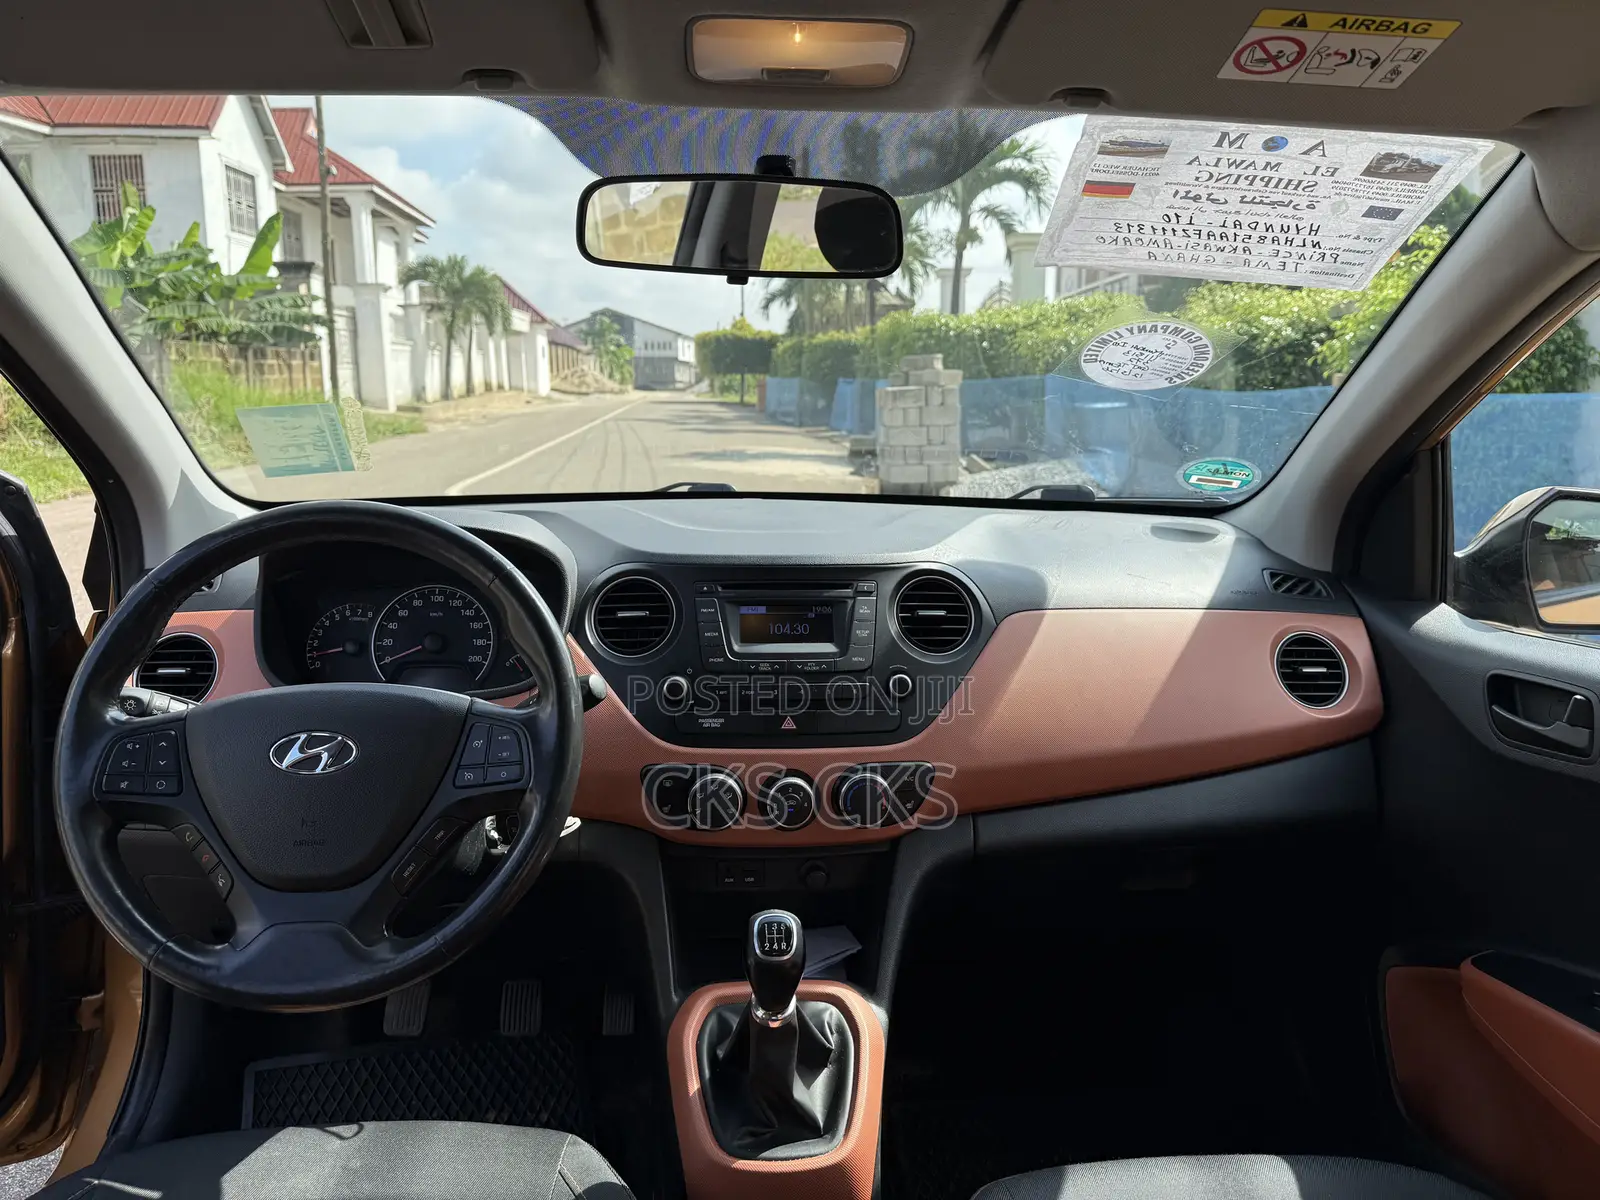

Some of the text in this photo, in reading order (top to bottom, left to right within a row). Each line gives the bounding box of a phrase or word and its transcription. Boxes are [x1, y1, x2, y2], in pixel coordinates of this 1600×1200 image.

[1329, 16, 1433, 35] AIRBAG
[768, 622, 810, 635] 104.30
[402, 862, 416, 878] RESET
